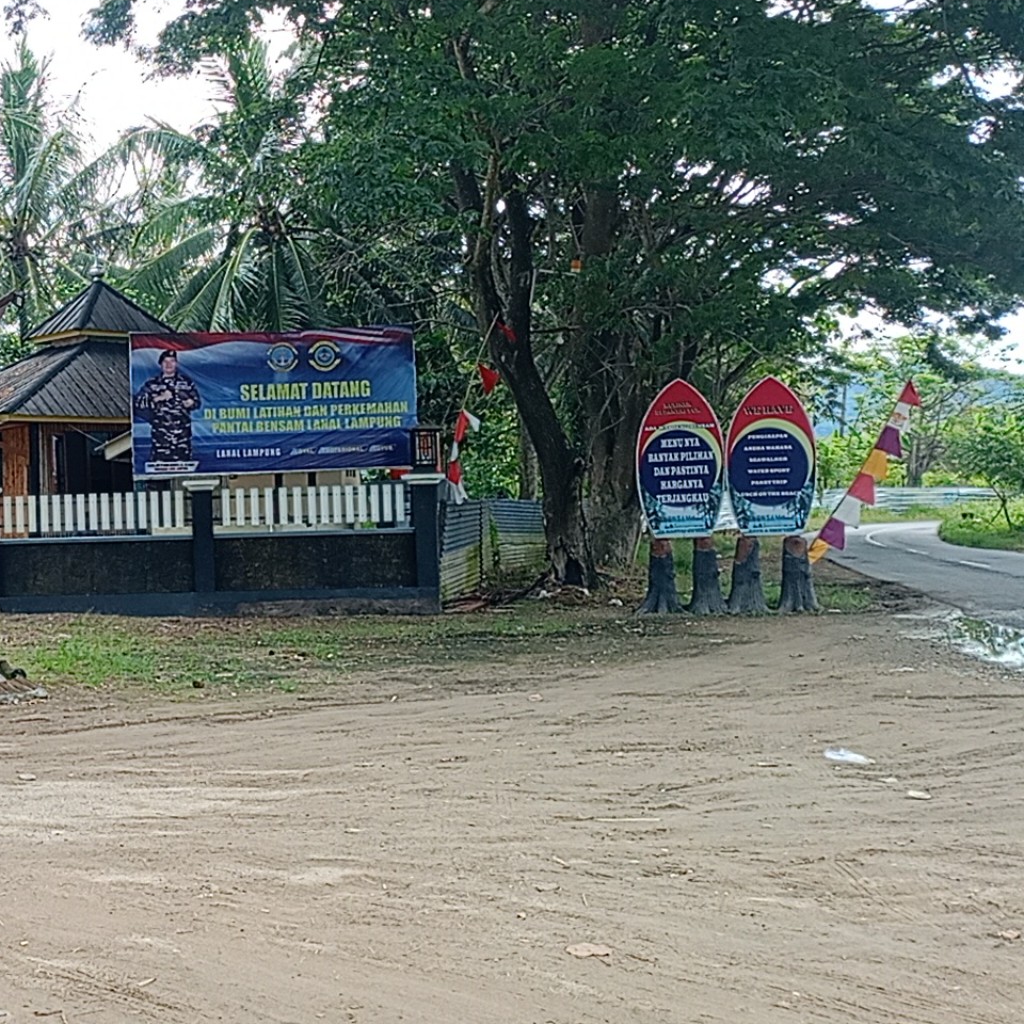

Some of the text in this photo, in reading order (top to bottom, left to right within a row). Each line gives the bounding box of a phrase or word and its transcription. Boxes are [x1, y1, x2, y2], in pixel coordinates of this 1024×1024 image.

[240, 380, 371, 401] SELAMAT DATANG
[204, 401, 408, 420] DI BUMI LATIHAN DAN PERKEMAHAN
[212, 416, 401, 433] PANTAI BENSAM LANAL LAMPUNG
